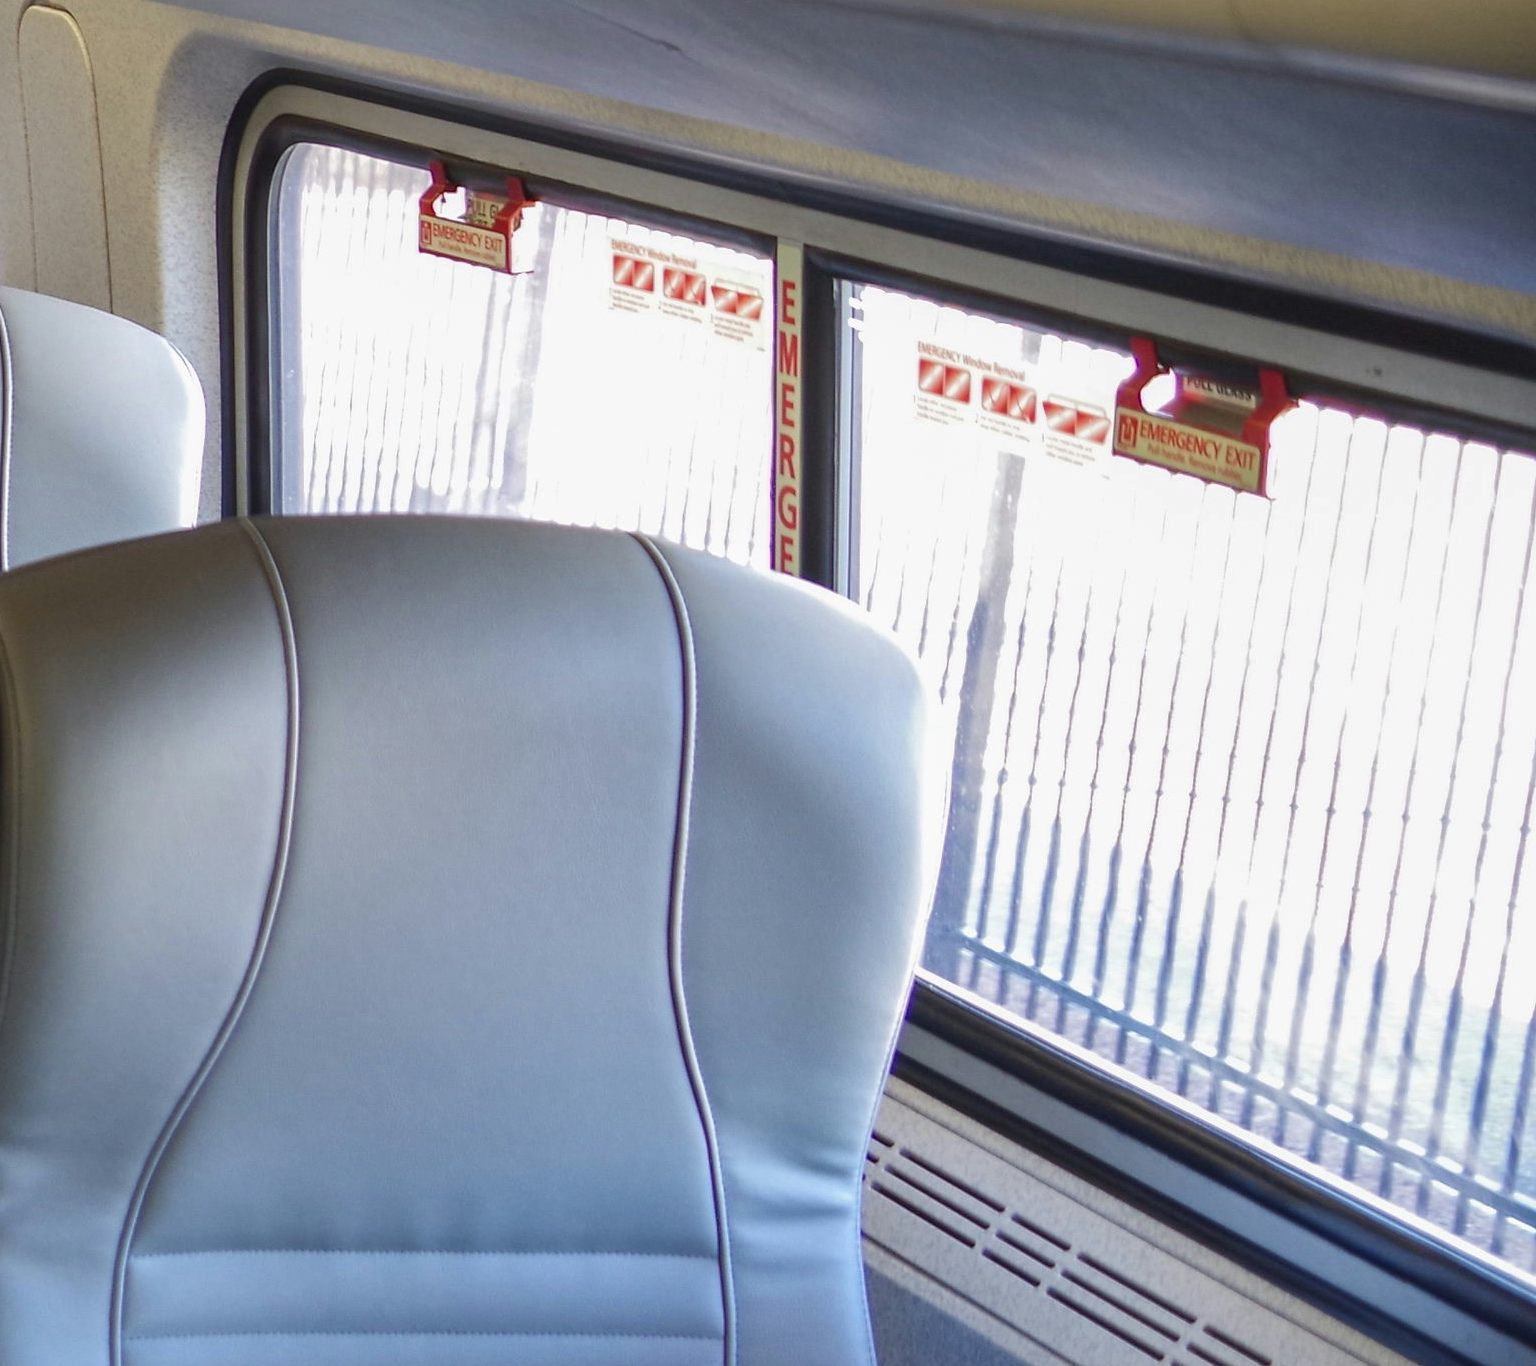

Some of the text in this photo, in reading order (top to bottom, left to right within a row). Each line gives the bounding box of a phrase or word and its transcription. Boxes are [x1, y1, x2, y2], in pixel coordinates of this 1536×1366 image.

[433, 223, 502, 253] EMERGENCY EXIT
[917, 340, 1026, 381] EMERGENCY Window Removal
[1140, 419, 1257, 470] EMERGENCY EXIT
